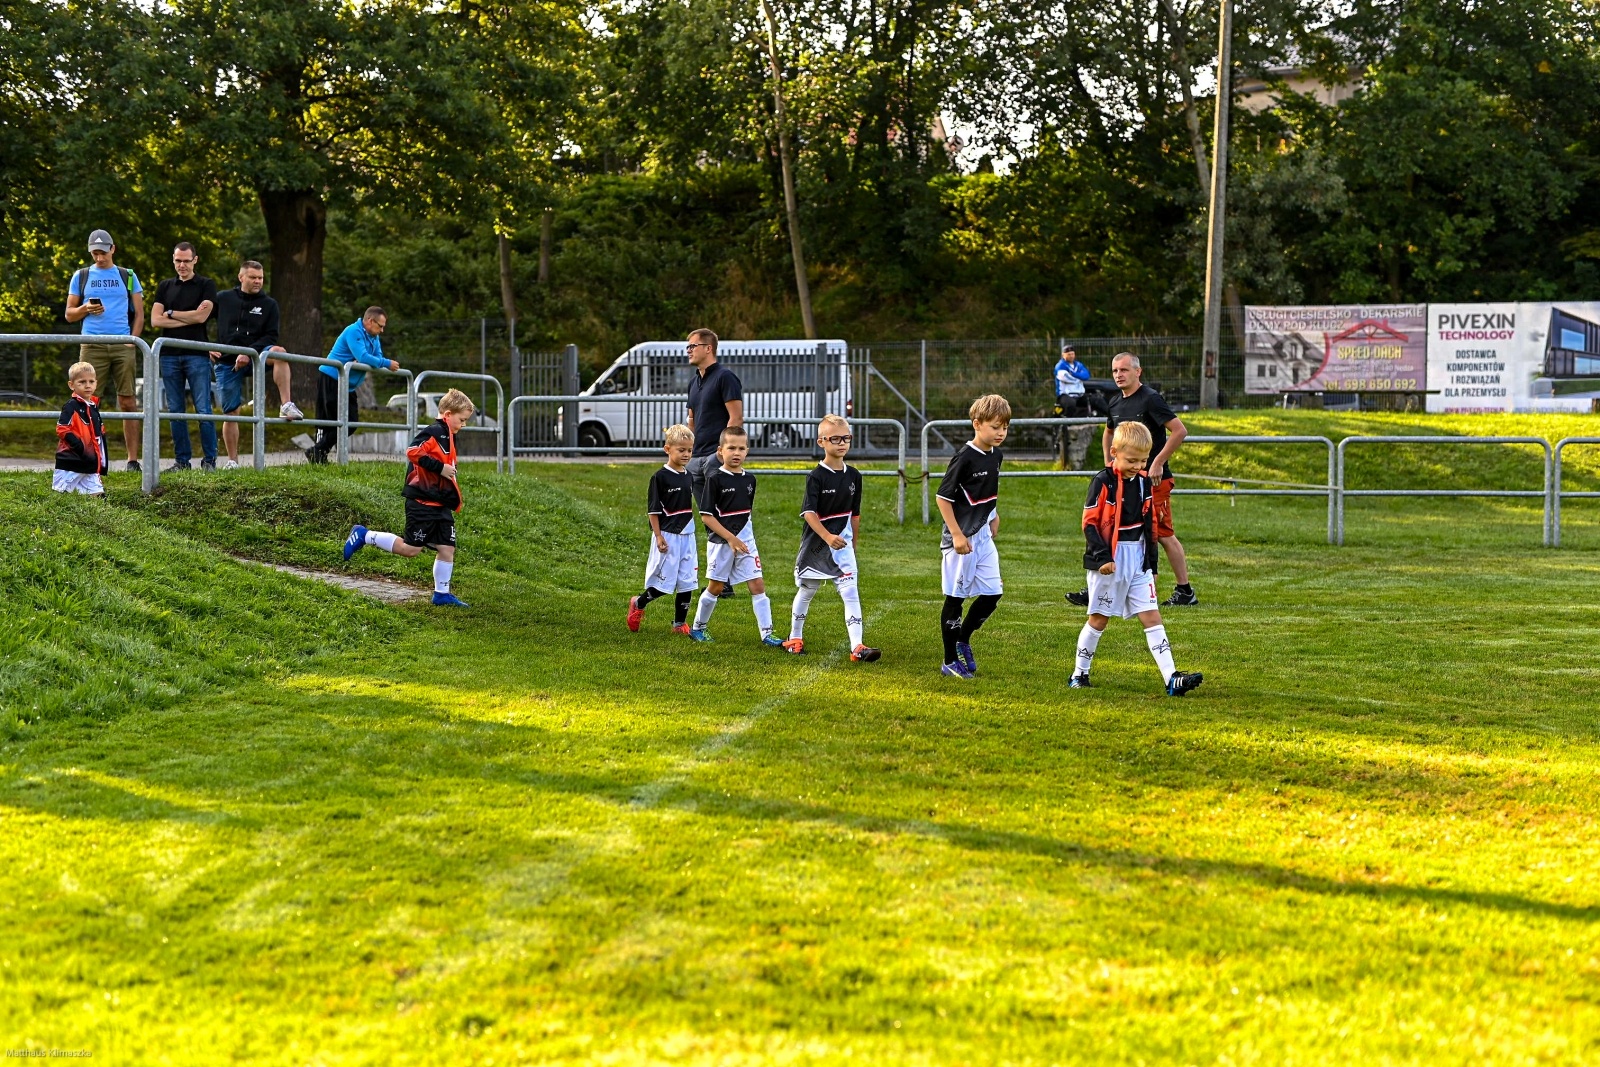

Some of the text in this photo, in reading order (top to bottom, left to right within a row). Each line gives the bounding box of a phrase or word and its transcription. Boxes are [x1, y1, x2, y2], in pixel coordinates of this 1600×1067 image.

[91, 279, 120, 288] BIG STAR
[1289, 308, 1352, 320] CIESIELSKO
[1360, 307, 1423, 318] DEKARSKIE
[1249, 320, 1281, 331] DOMY
[1283, 320, 1307, 331] POD
[1438, 313, 1515, 329] PIVEXIN
[1438, 330, 1515, 340] TECHNOLOGY
[1456, 349, 1497, 359] DOSTAWCA
[1447, 361, 1505, 372] KOMPONENTÓW
[1345, 379, 1367, 390] 698
[1369, 379, 1392, 390] 650
[1394, 378, 1417, 390] 692
[1451, 373, 1501, 386] I ROZWIĄZAŃ
[1445, 387, 1507, 397] DLA PRZEMYSŁU
